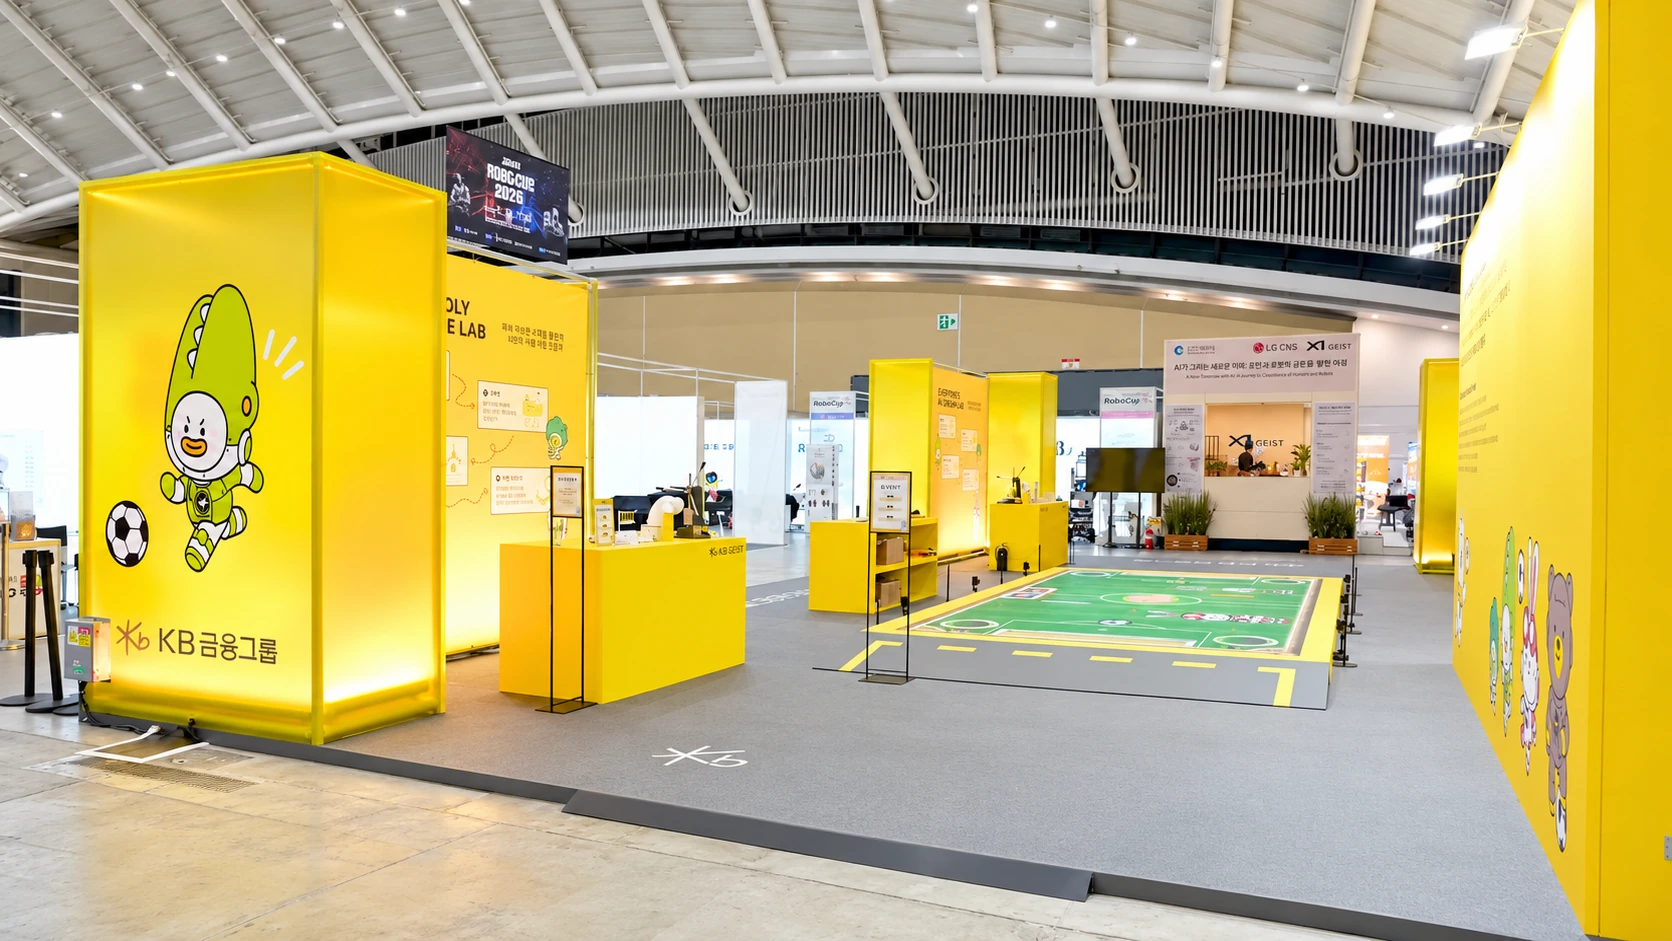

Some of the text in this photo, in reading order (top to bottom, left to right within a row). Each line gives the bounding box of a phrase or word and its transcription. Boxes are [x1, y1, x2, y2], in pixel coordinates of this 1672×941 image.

[495, 185, 523, 205] 2026
[460, 320, 486, 339] LAB
[1266, 343, 1298, 352] LG CNS
